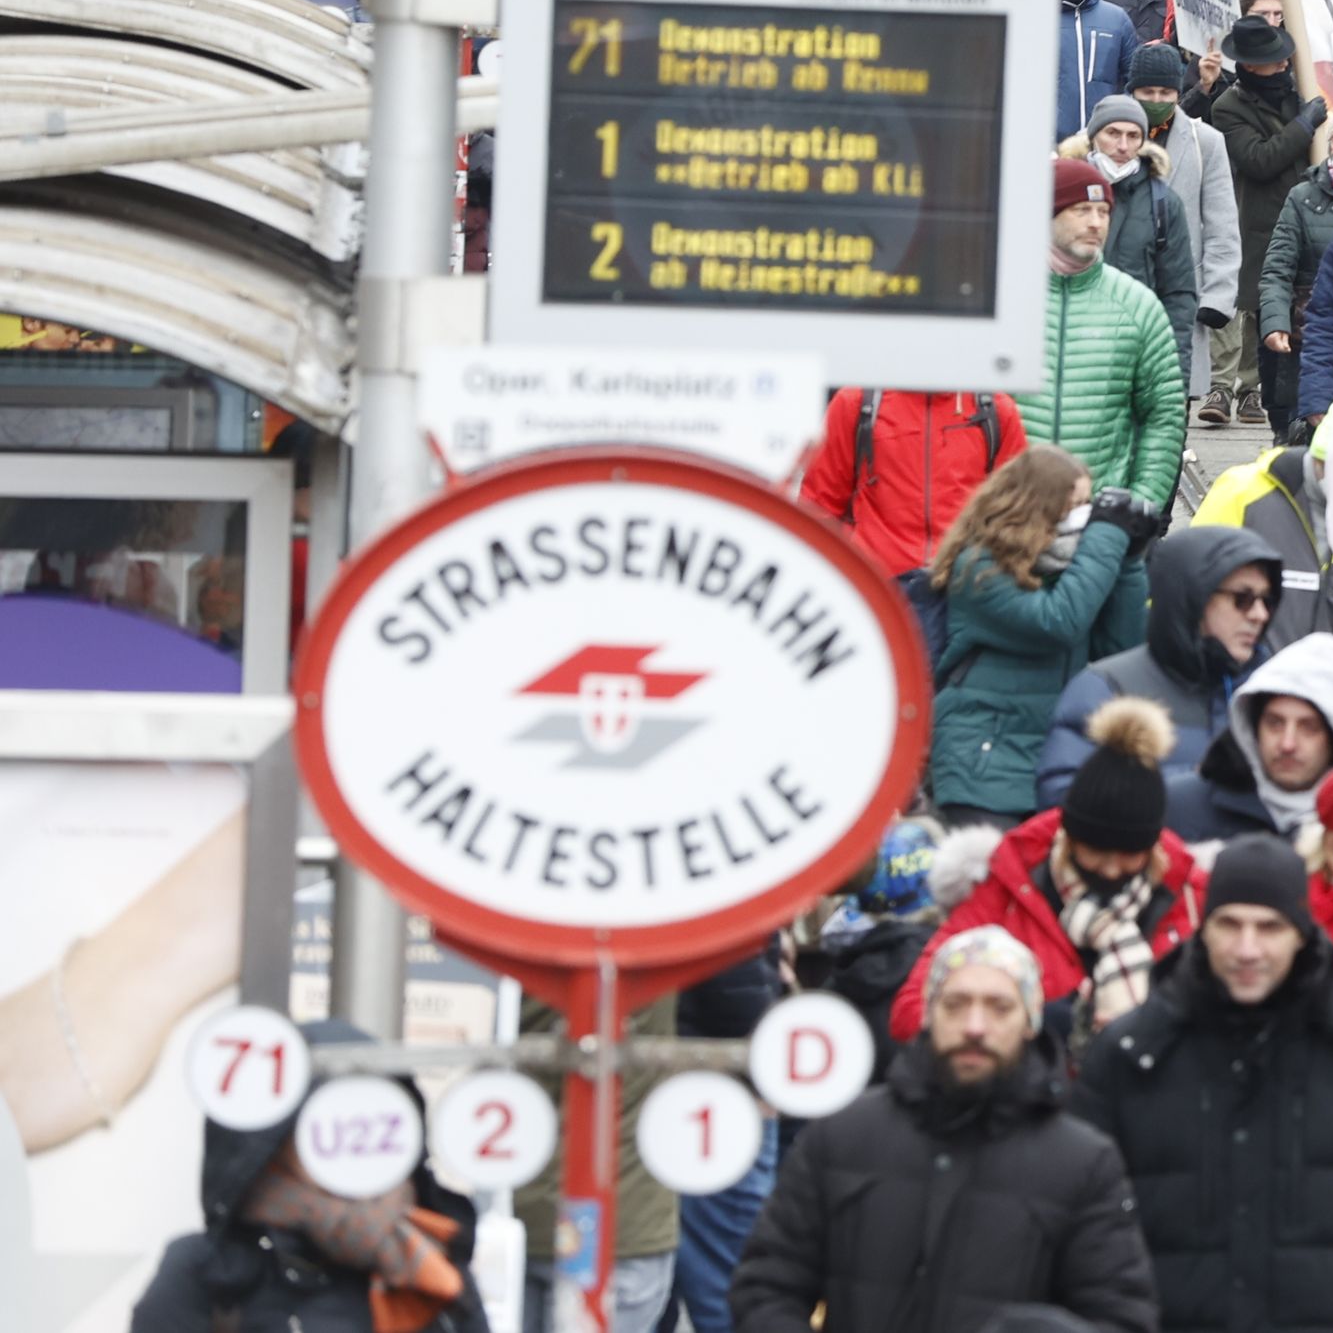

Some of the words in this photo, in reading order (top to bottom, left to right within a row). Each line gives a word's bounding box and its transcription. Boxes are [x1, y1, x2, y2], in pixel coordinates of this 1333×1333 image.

[568, 17, 623, 77] 71
[659, 19, 882, 62] Demonstration
[658, 52, 779, 92] Betrieb
[793, 61, 828, 92] ab
[596, 120, 621, 179] 1
[656, 119, 877, 164] Demonstration
[822, 163, 858, 195] ab
[591, 222, 623, 281] 2
[651, 222, 874, 265] Demonstration
[649, 259, 687, 292] ab
[377, 513, 858, 687] STRASSENBAHN
[385, 749, 826, 893] HALTESTELLE
[214, 1037, 289, 1096] 71
[788, 1028, 836, 1084] D
[310, 1116, 407, 1160] U2Z
[473, 1101, 518, 1162] 2
[687, 1106, 716, 1161] 1
